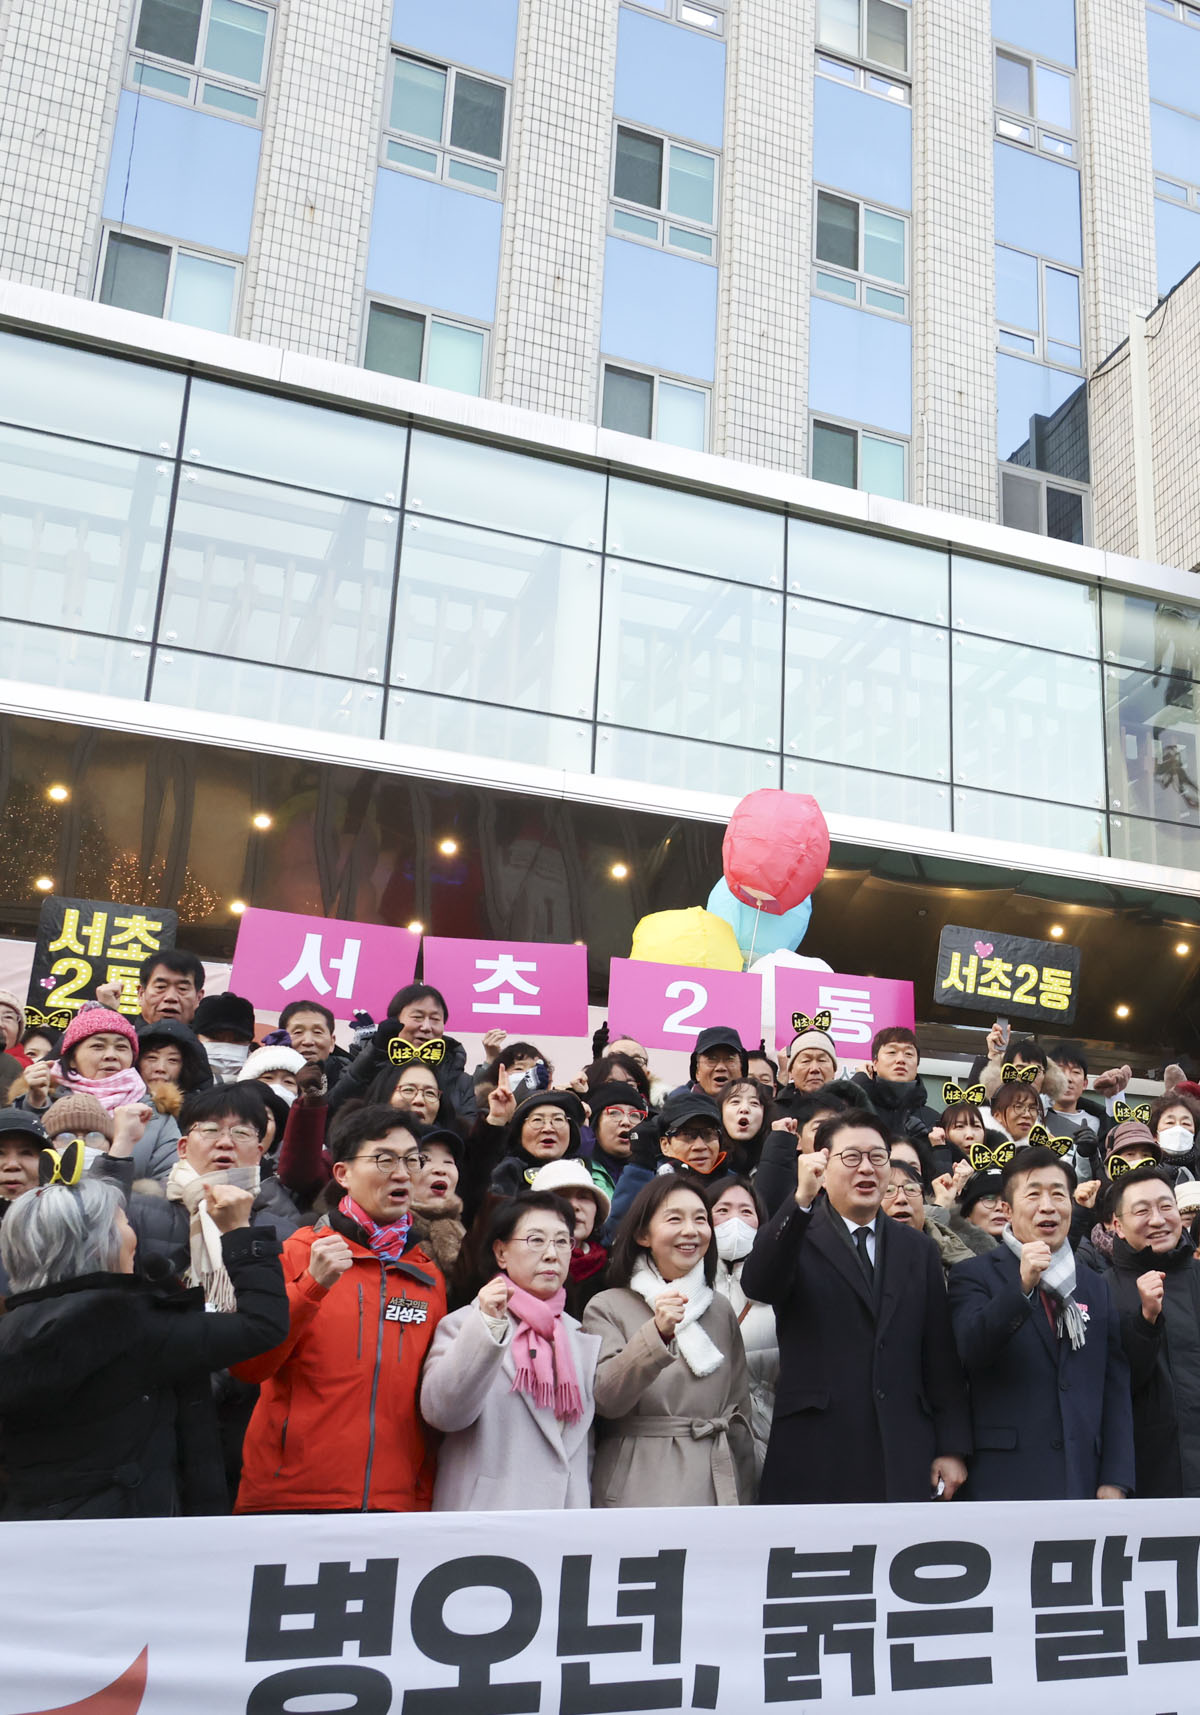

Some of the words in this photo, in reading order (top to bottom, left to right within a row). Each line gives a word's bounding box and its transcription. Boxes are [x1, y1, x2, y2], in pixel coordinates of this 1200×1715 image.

[48, 908, 163, 962] 서초
[941, 951, 1073, 1011] 서초2동
[391, 1047, 412, 1060] 서초
[945, 1090, 961, 1100] 서초
[974, 1152, 991, 1164] 서초
[385, 1304, 428, 1325] 김성주
[244, 1548, 722, 1715] 병오년,
[762, 1541, 994, 1704] 붉은
